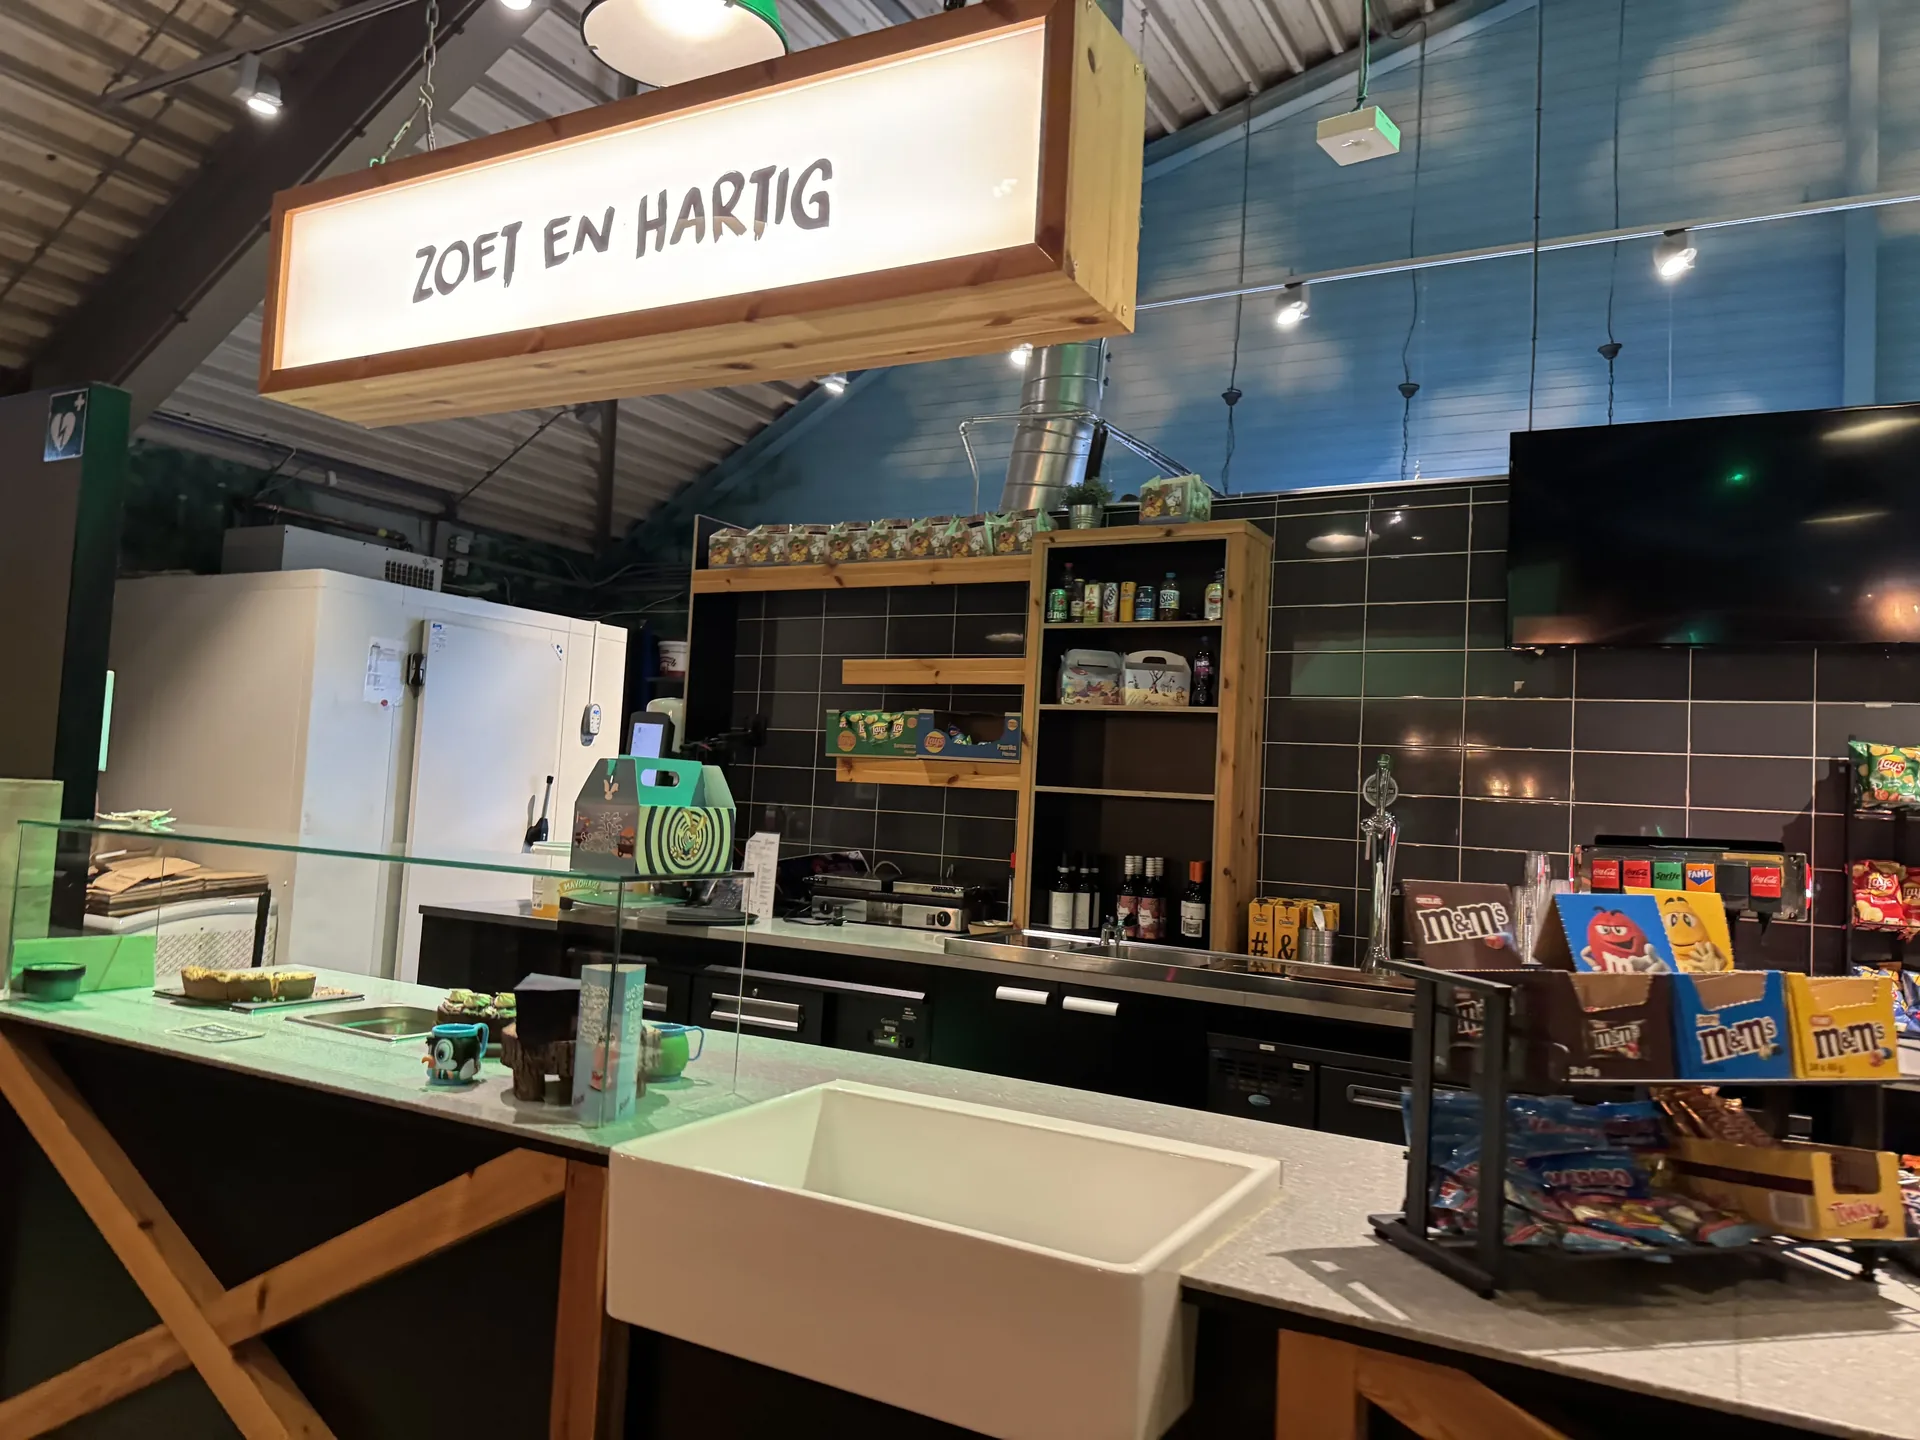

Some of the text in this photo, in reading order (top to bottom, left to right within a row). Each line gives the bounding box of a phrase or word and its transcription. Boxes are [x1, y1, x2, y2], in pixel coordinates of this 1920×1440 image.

[412, 157, 834, 303] ZOET EN HARTIG
[1655, 871, 1681, 882] Sprite
[1687, 870, 1713, 880] FANTA
[1251, 931, 1268, 956] #
[1277, 934, 1296, 960] &
